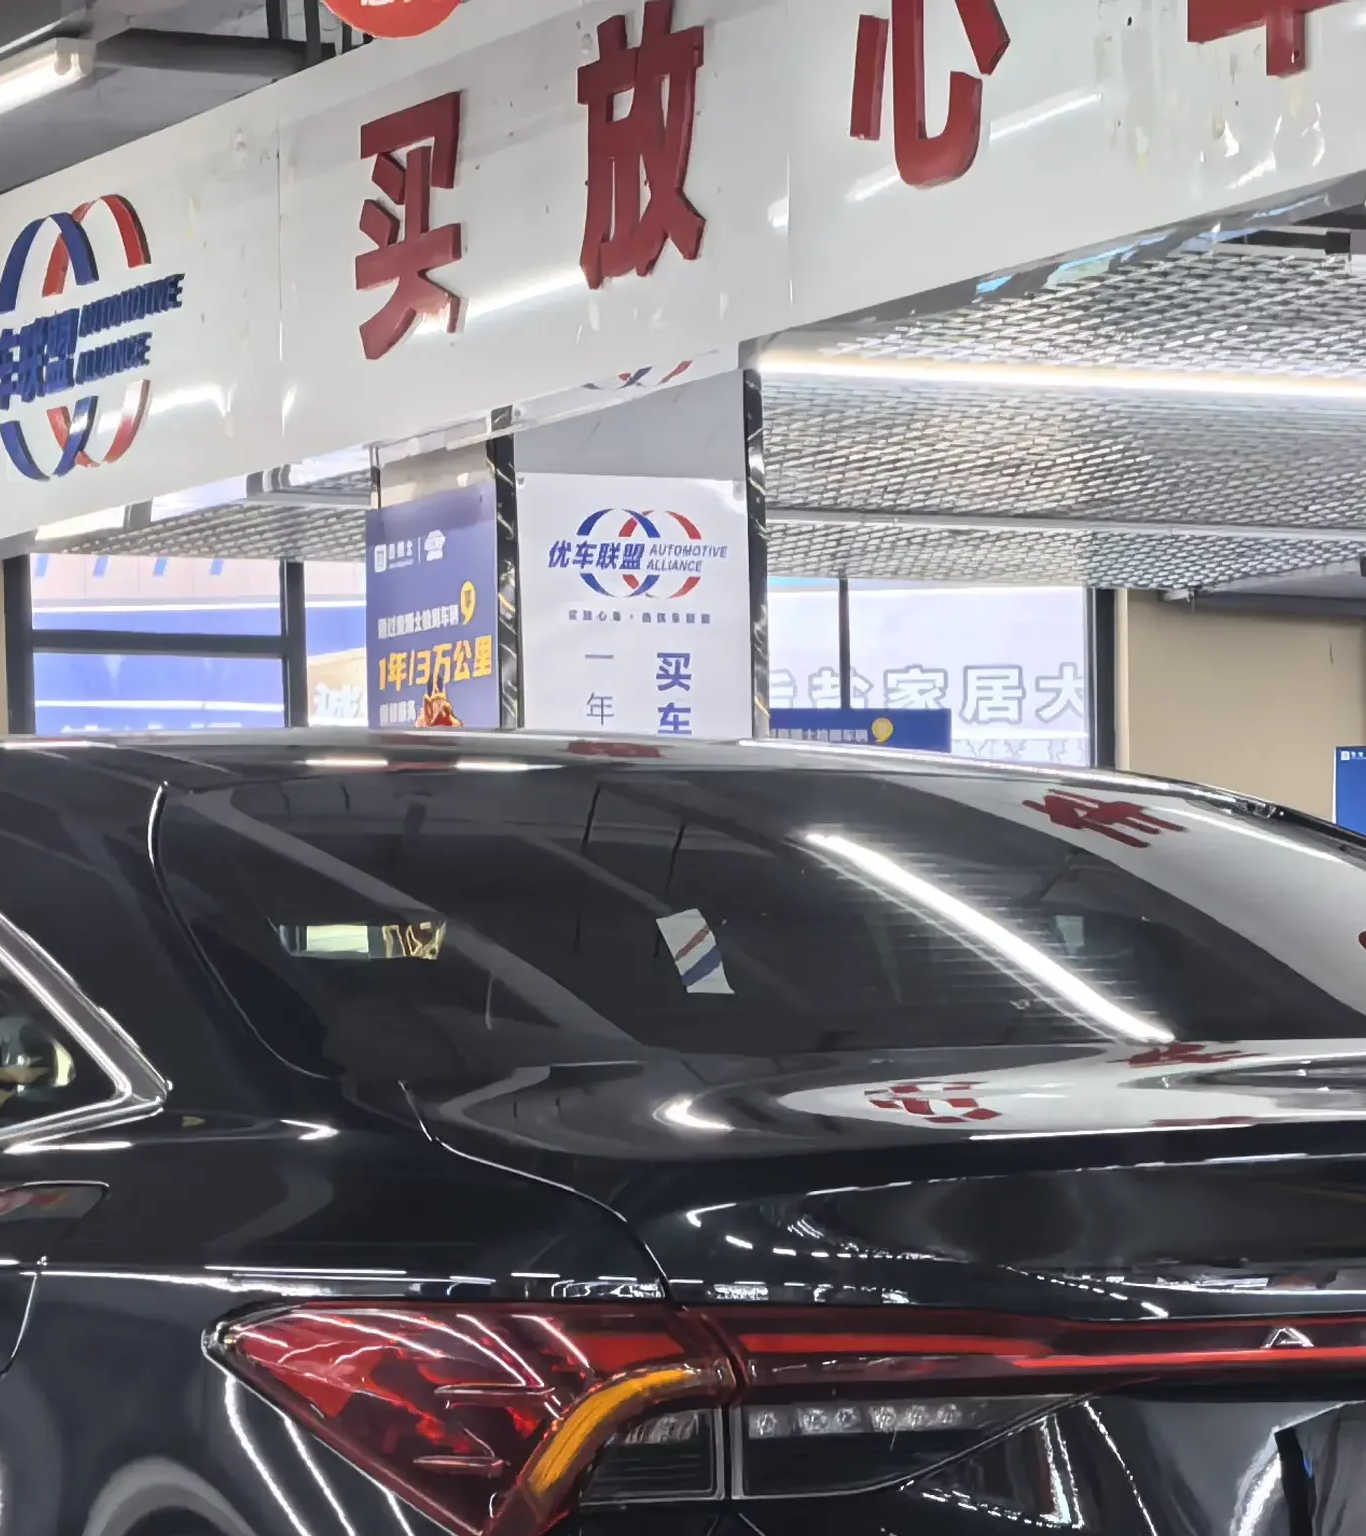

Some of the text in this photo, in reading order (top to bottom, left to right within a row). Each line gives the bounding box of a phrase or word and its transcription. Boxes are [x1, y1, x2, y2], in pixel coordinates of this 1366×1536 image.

[548, 540, 645, 569] 优车联盟
[649, 543, 728, 558] AUTOMOTIVE
[646, 560, 703, 573] ALLIANCE
